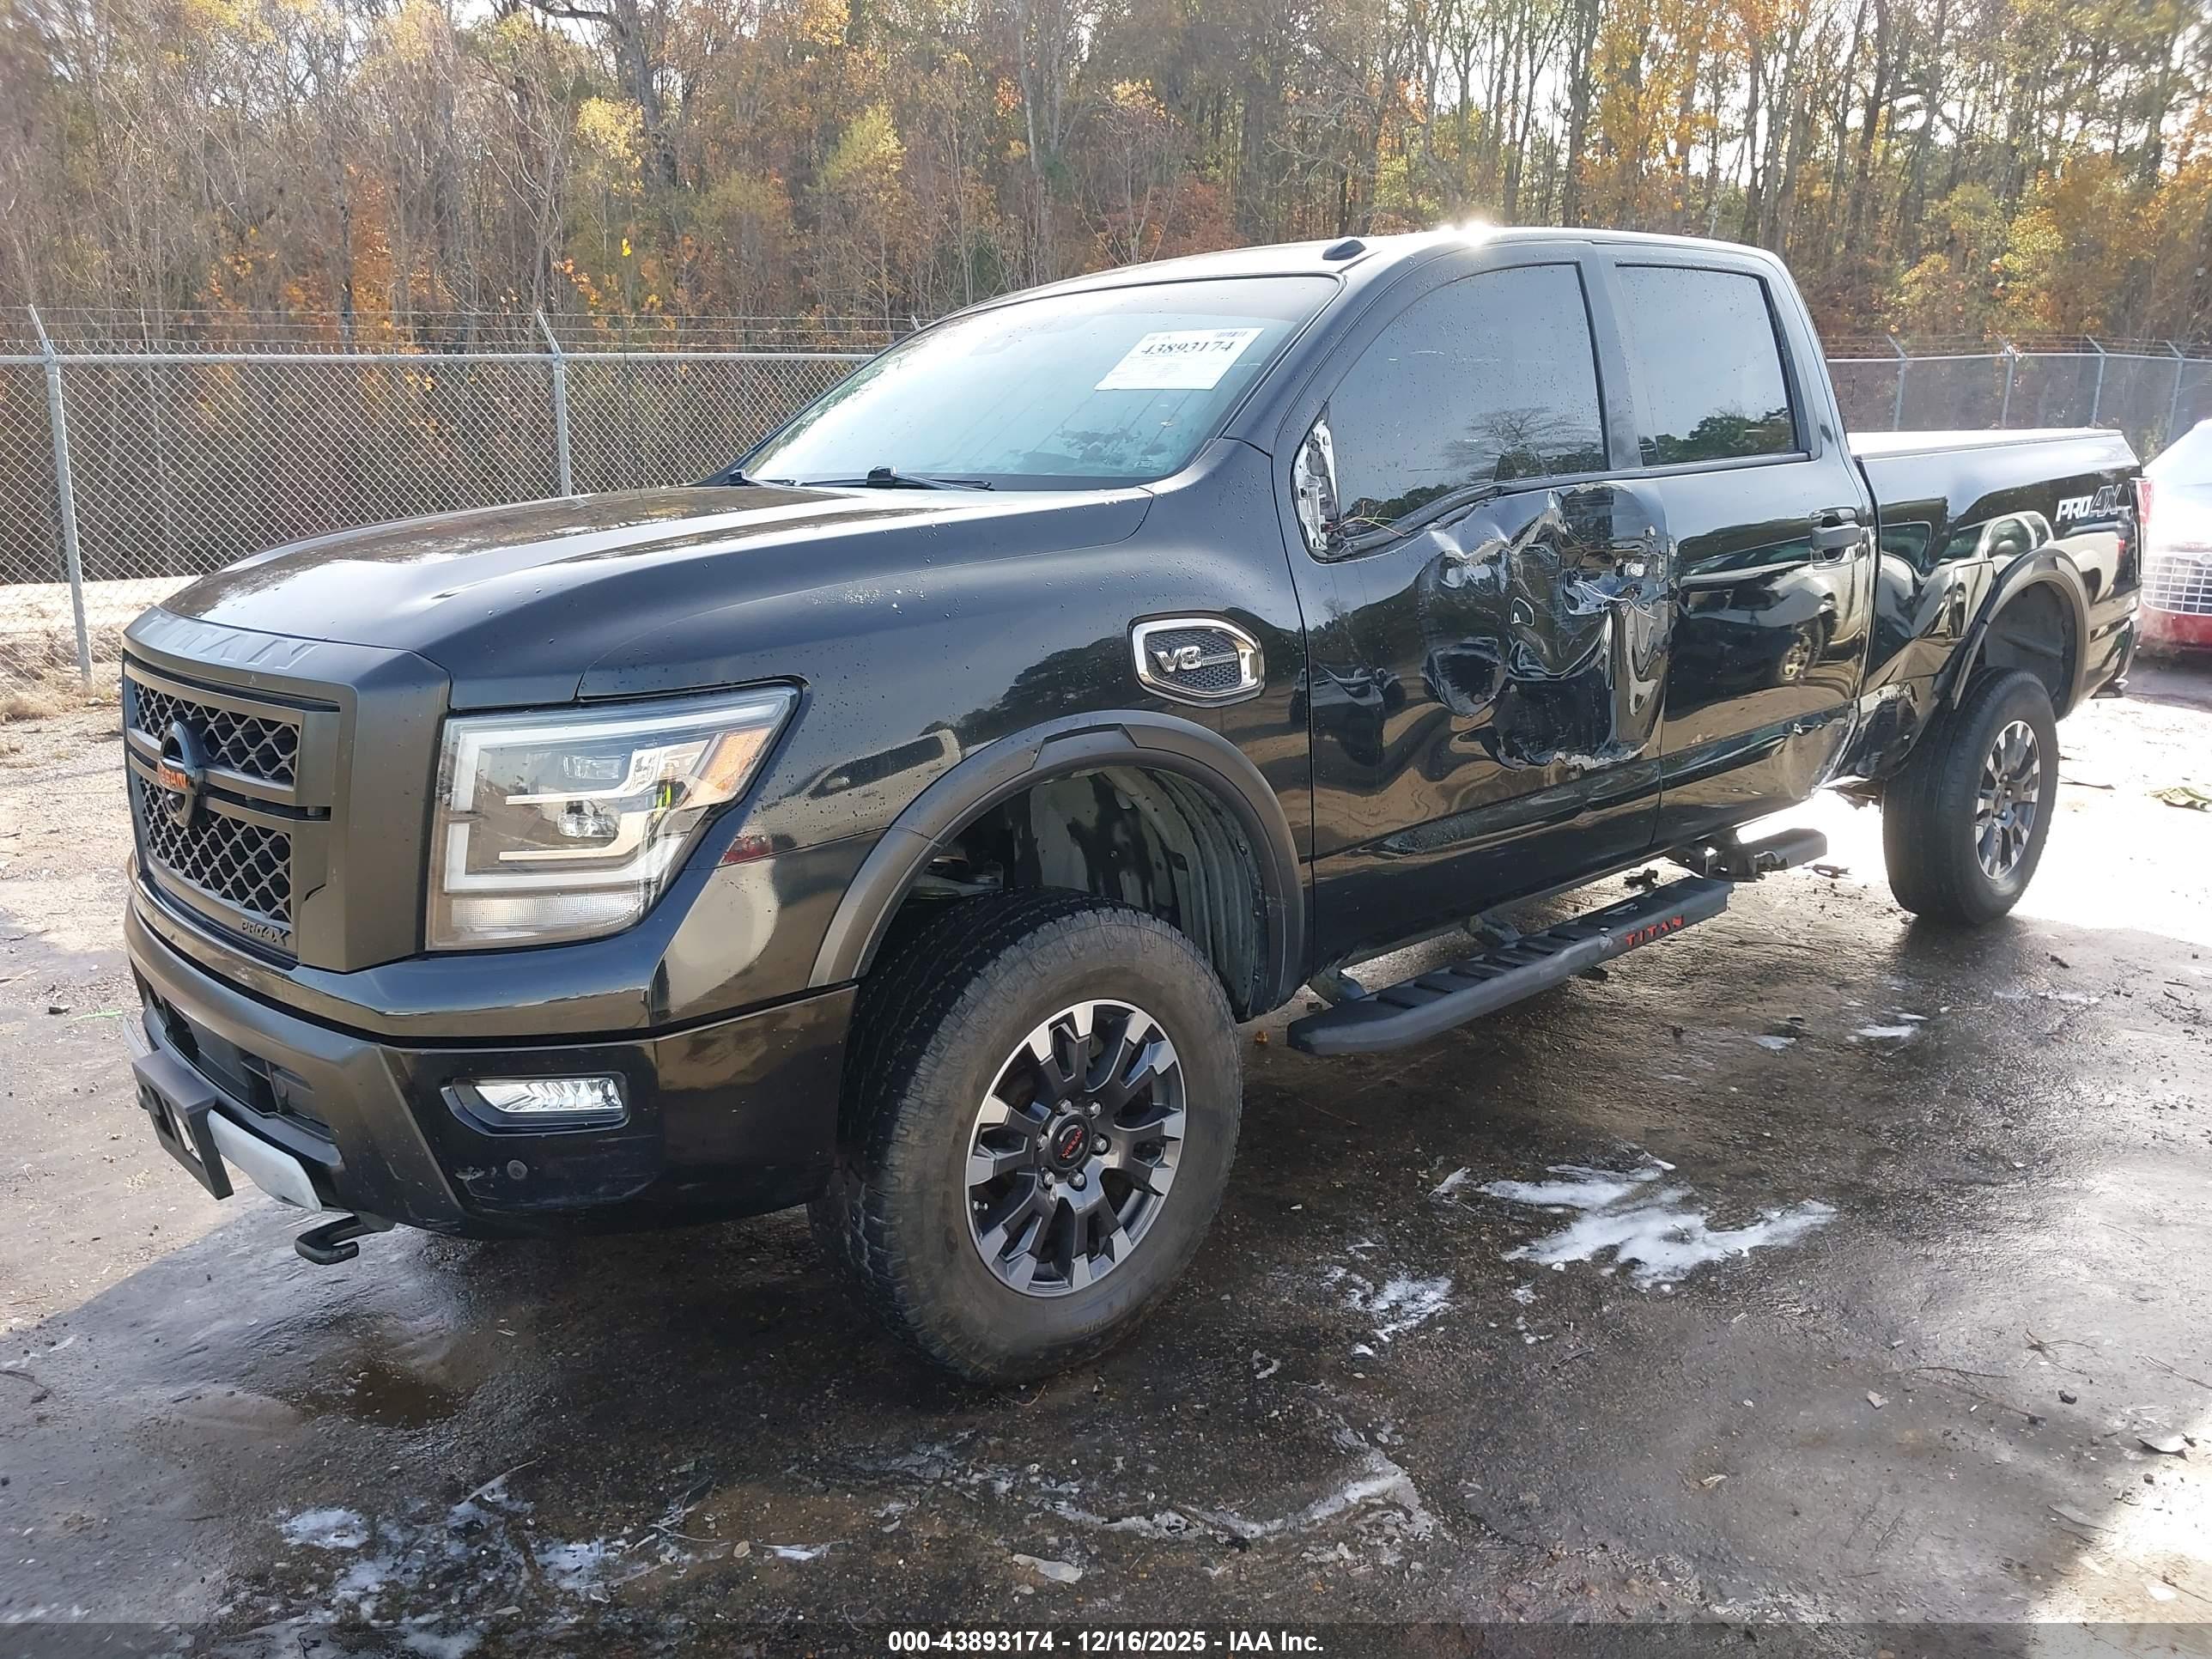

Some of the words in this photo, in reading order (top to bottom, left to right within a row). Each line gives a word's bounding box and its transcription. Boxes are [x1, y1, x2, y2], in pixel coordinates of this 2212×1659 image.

[1140, 341, 1235, 355] 43893174
[137, 613, 320, 671] TITAN
[1152, 646, 1202, 673] V8
[158, 767, 187, 789] SSAN
[1626, 915, 1685, 946] TITAN
